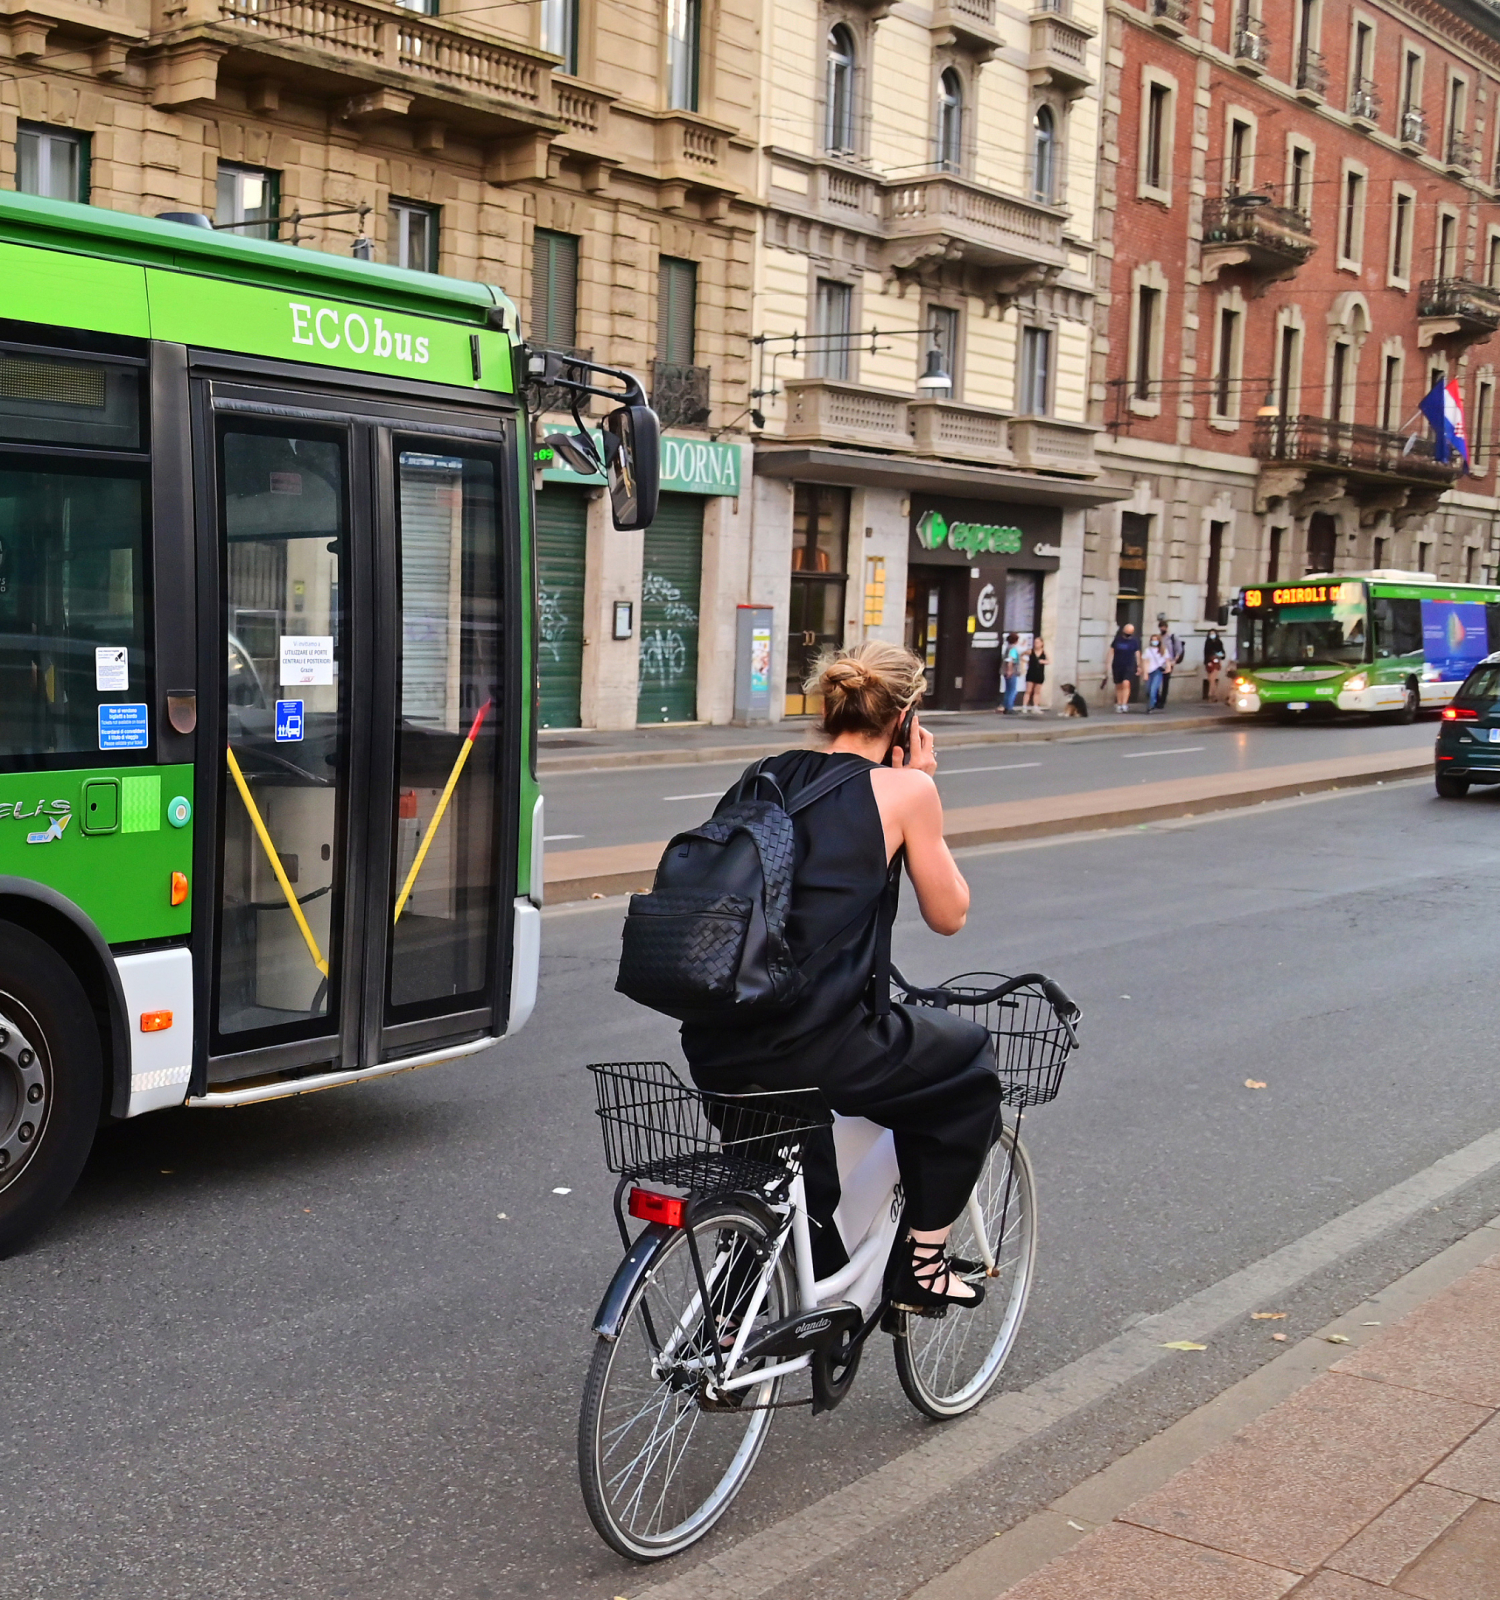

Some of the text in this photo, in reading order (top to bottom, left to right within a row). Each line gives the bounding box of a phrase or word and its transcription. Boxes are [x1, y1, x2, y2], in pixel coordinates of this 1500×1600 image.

[289, 302, 430, 364] ECObus
[948, 521, 1023, 560] express
[1273, 586, 1327, 604] CAIROLI
[795, 1317, 829, 1334] olanda
